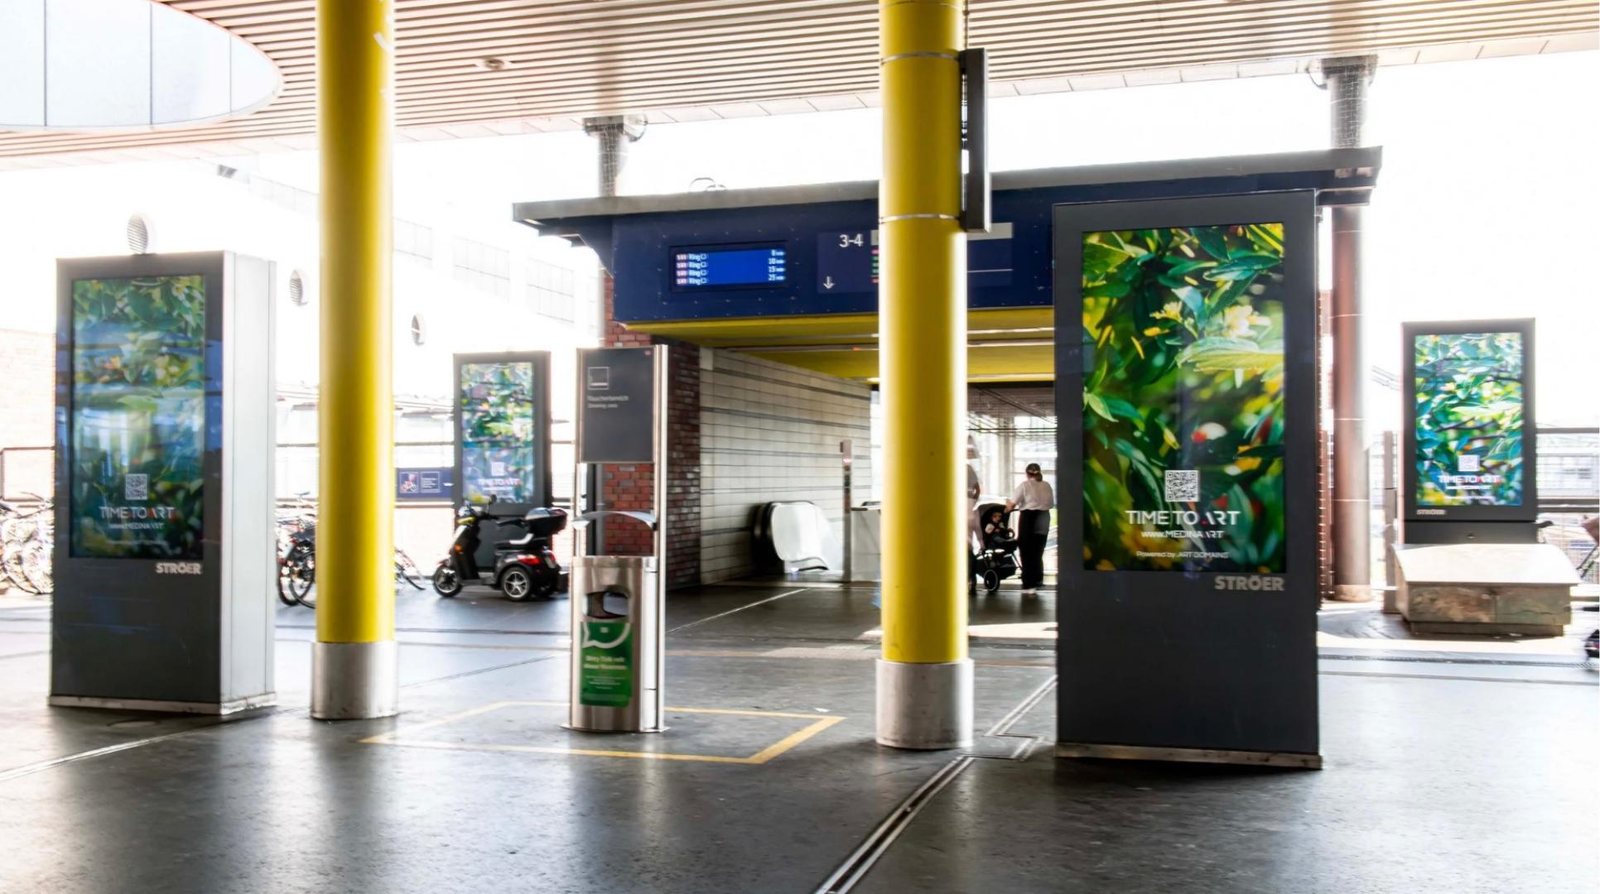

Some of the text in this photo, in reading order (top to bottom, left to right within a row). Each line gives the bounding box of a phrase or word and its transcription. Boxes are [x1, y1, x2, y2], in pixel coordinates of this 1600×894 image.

[839, 233, 864, 248] 3-4
[99, 506, 175, 519] TIME TO ART
[1125, 510, 1241, 525] TIME TO ART
[155, 562, 202, 574] STRÖER
[1214, 575, 1284, 591] STRÖER
